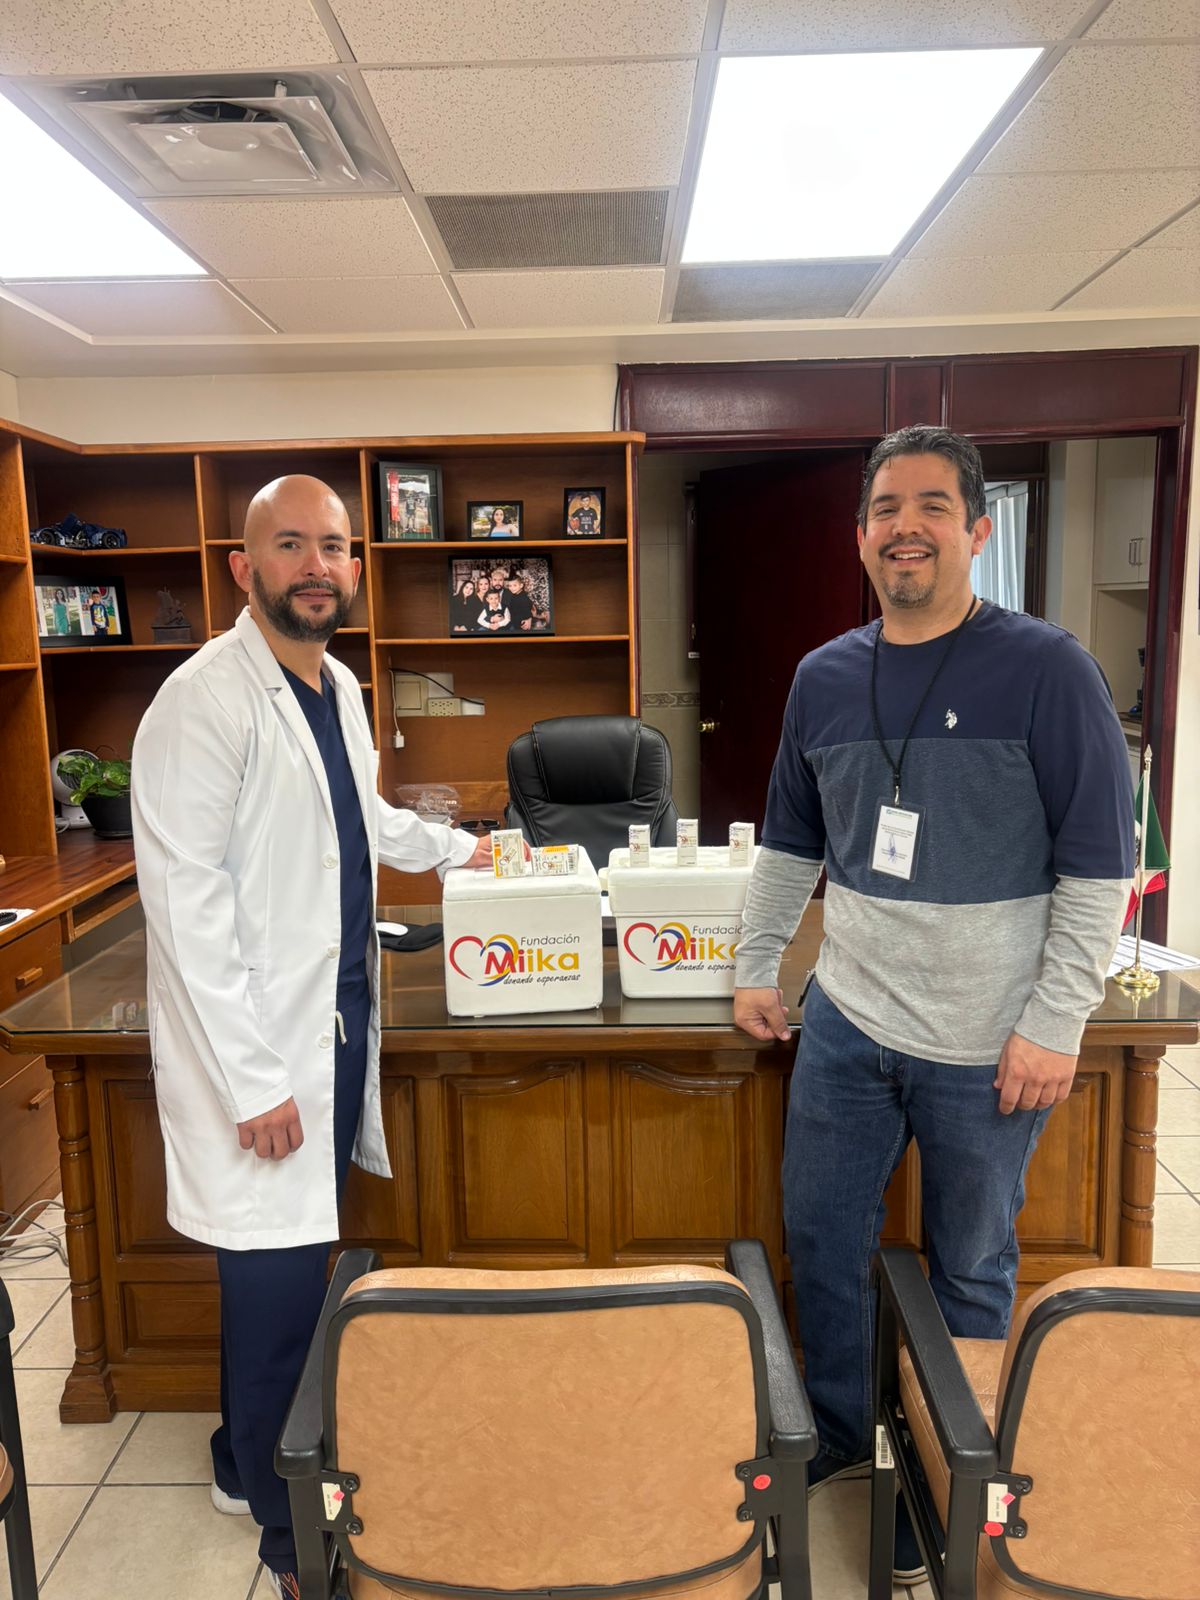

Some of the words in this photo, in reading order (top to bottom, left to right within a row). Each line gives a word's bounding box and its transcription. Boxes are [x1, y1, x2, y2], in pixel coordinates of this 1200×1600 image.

[693, 924, 743, 935] Fundació
[520, 933, 580, 946] Fundación
[484, 948, 580, 975] Miika
[675, 961, 704, 971] donando
[707, 964, 736, 974] espera
[503, 973, 534, 985] donando
[536, 974, 581, 987] esperanzas
